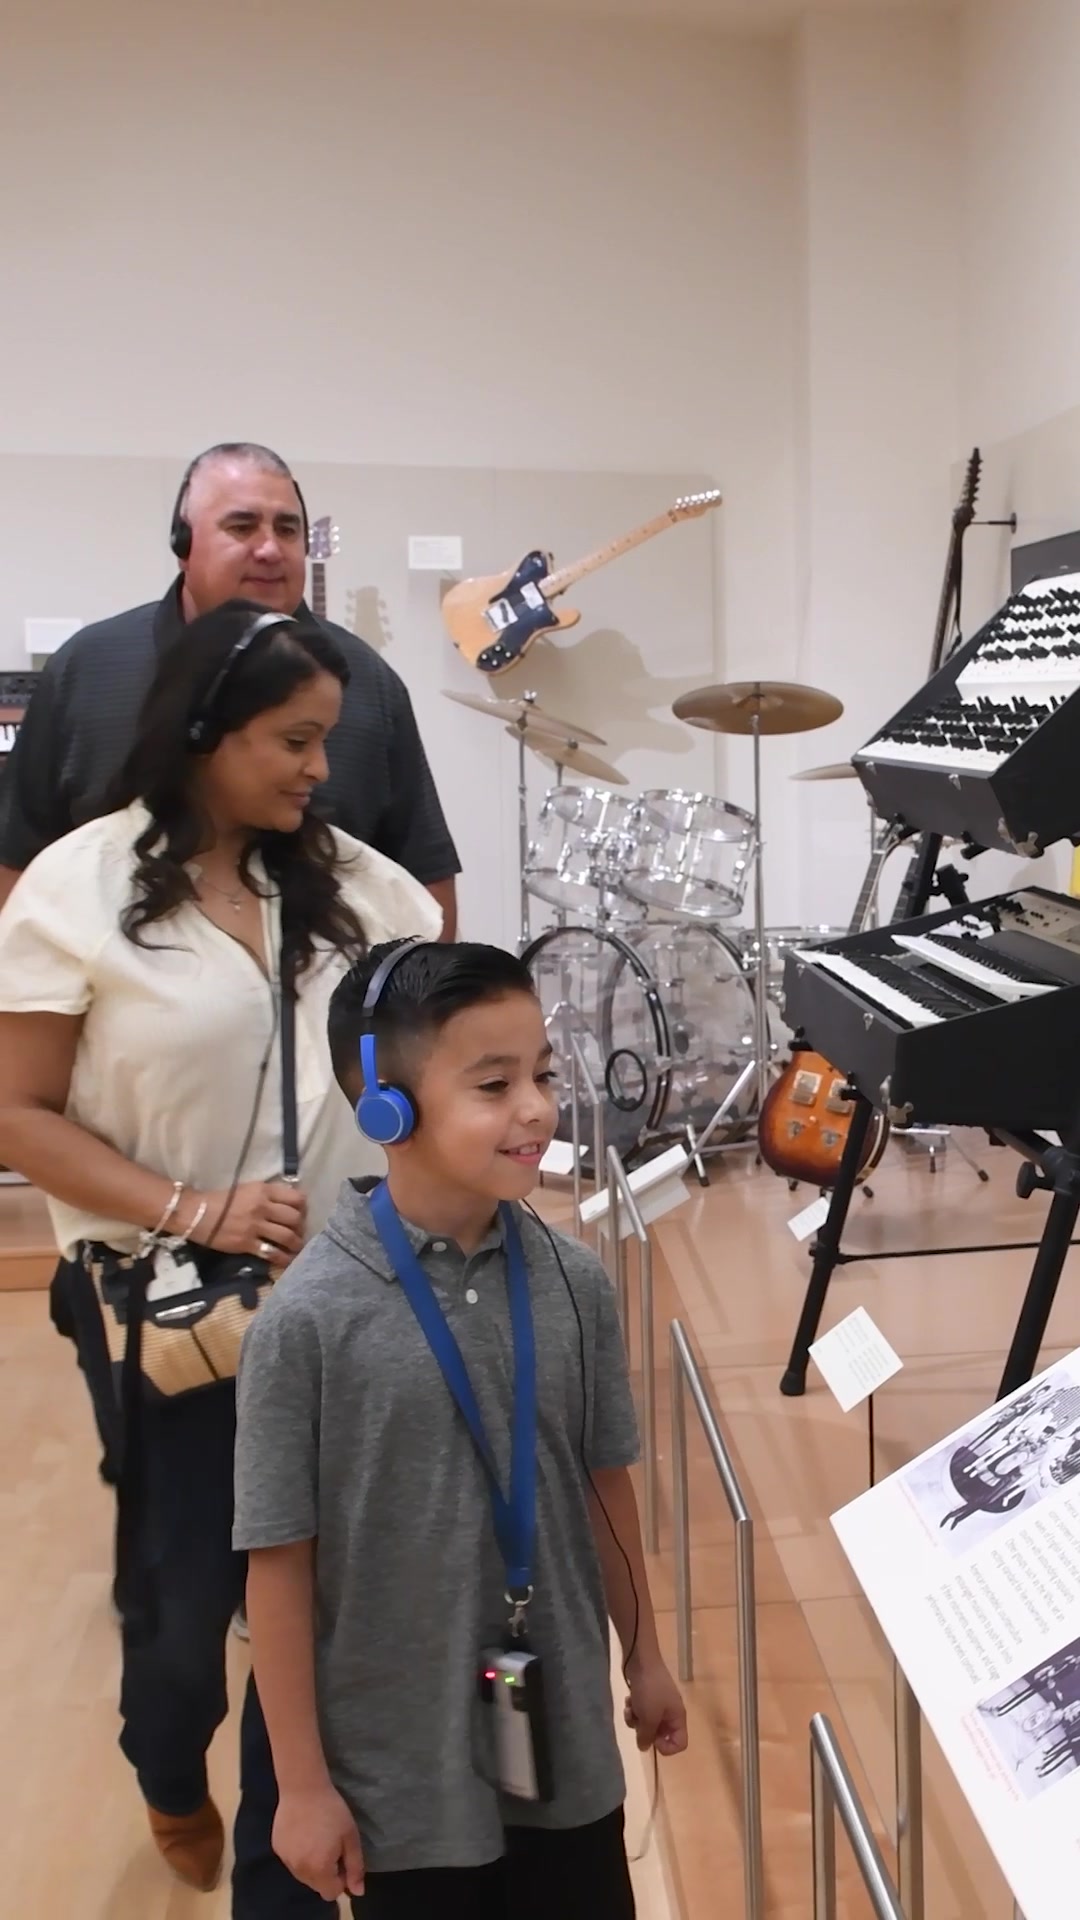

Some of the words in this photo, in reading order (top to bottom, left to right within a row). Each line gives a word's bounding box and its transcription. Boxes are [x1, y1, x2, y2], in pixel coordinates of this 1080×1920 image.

[1046, 1535, 1062, 1552] English
[1057, 1551, 1071, 1567] bands
[1036, 1583, 1046, 1594] the
[985, 1627, 1000, 1641] push
[994, 1639, 1004, 1650] the
[980, 1655, 994, 1666] and
